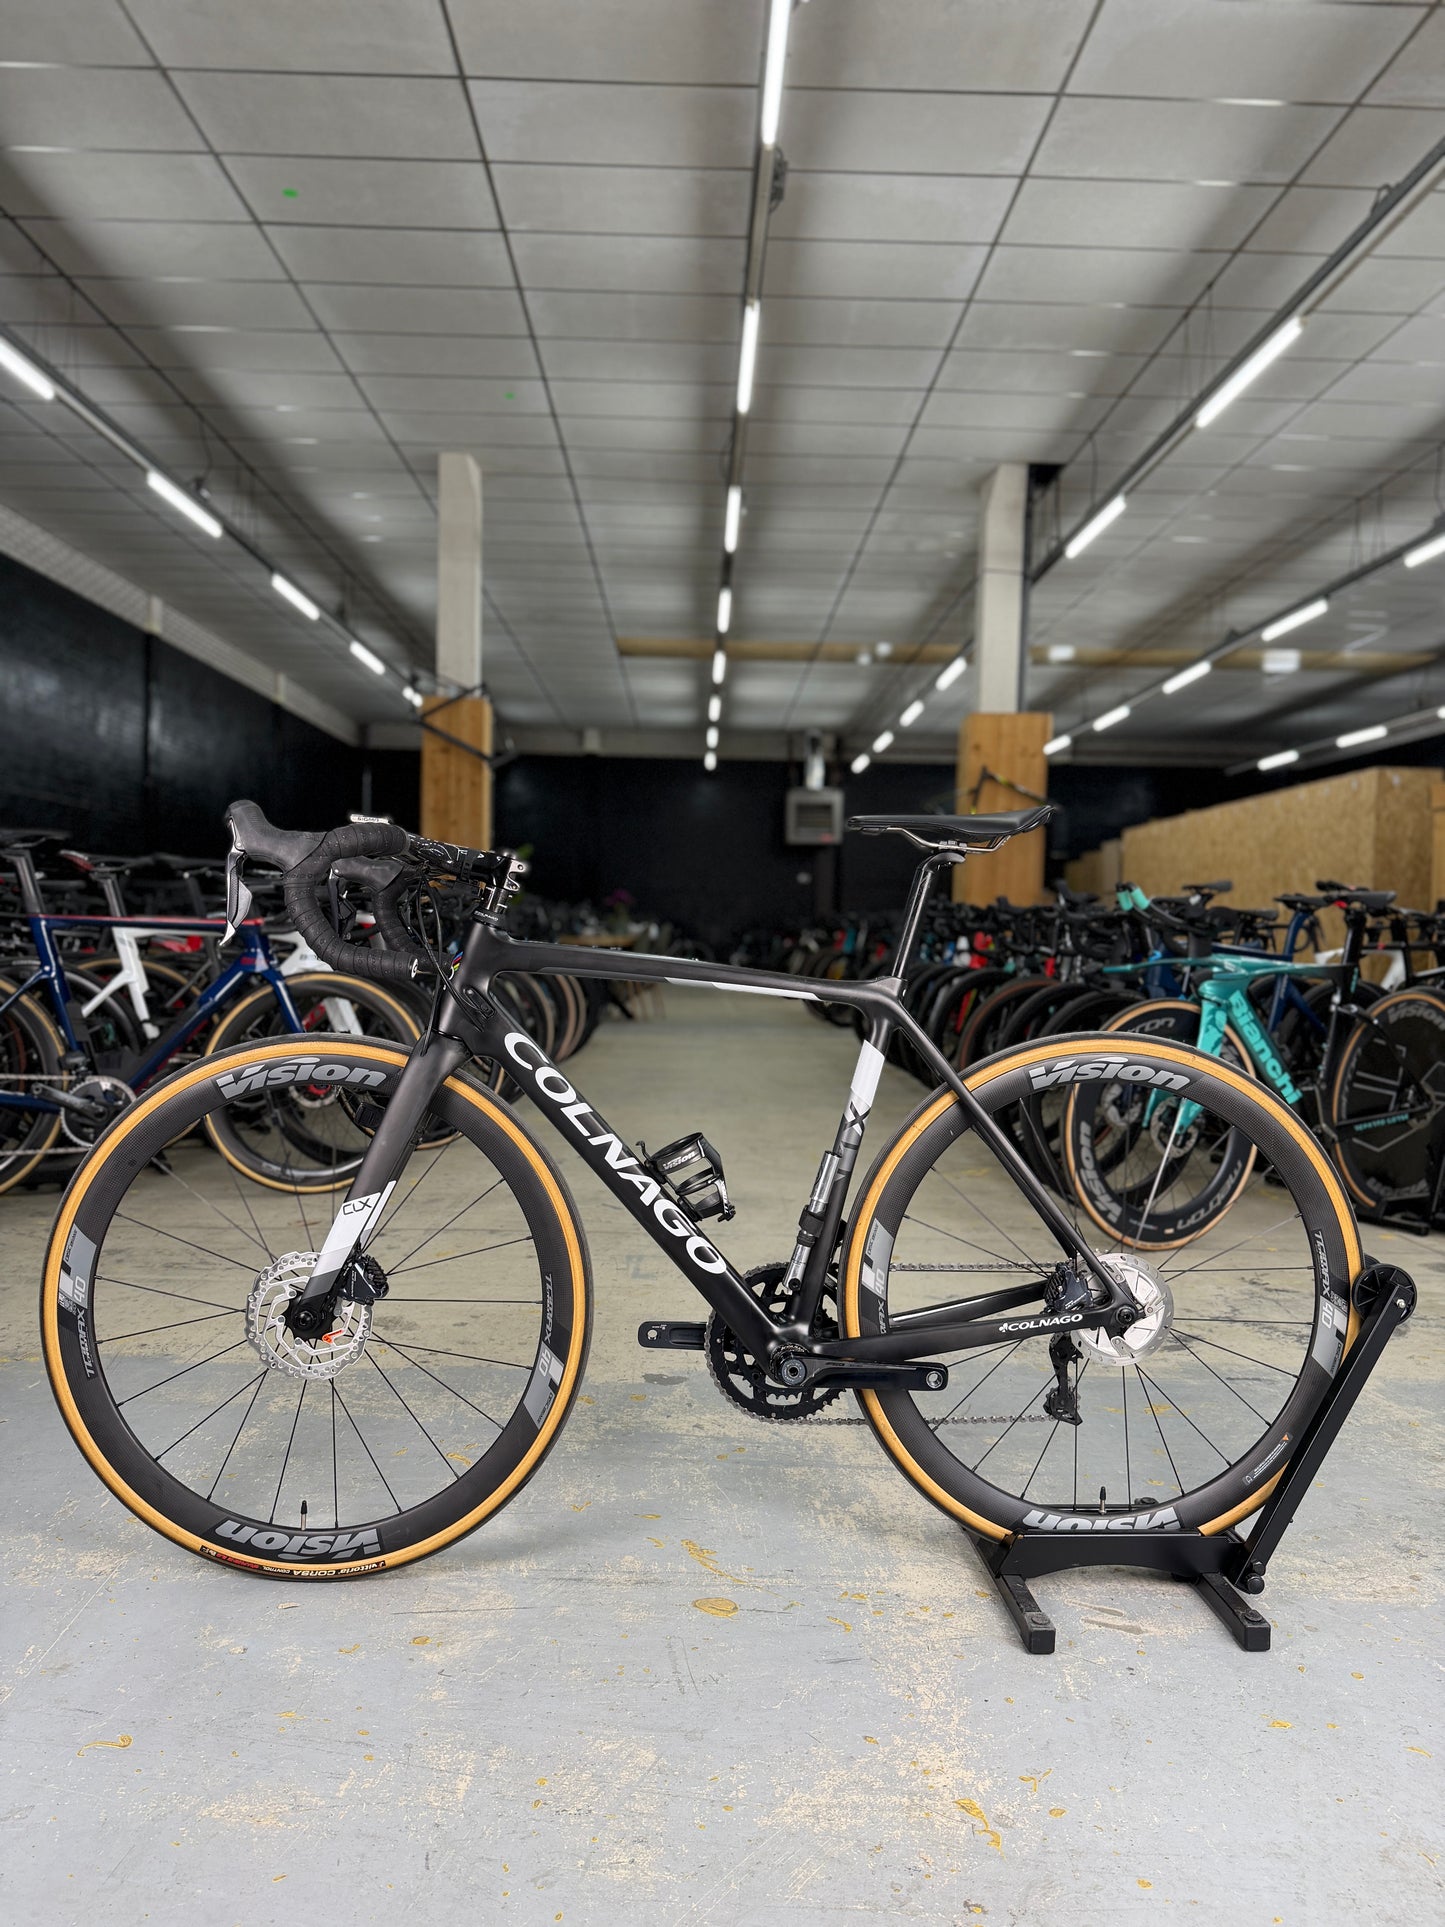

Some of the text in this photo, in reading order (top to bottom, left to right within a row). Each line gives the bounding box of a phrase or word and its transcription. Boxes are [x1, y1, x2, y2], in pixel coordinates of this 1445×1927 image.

[1229, 990, 1303, 1105] Bianchi
[216, 1057, 387, 1099] Vision
[1029, 1057, 1191, 1091] Vision
[504, 1032, 727, 1275] COLNAGO
[1080, 1120, 1122, 1224] Vision
[342, 1198, 372, 1216] CLX
[73, 1275, 87, 1304] 40
[875, 1268, 886, 1295] 40
[1009, 1313, 1084, 1332] COLNAGO
[1321, 1302, 1333, 1329] 40
[538, 1349, 552, 1378] 40
[214, 1519, 382, 1560] Vision
[293, 1569, 337, 1577] CORSA
